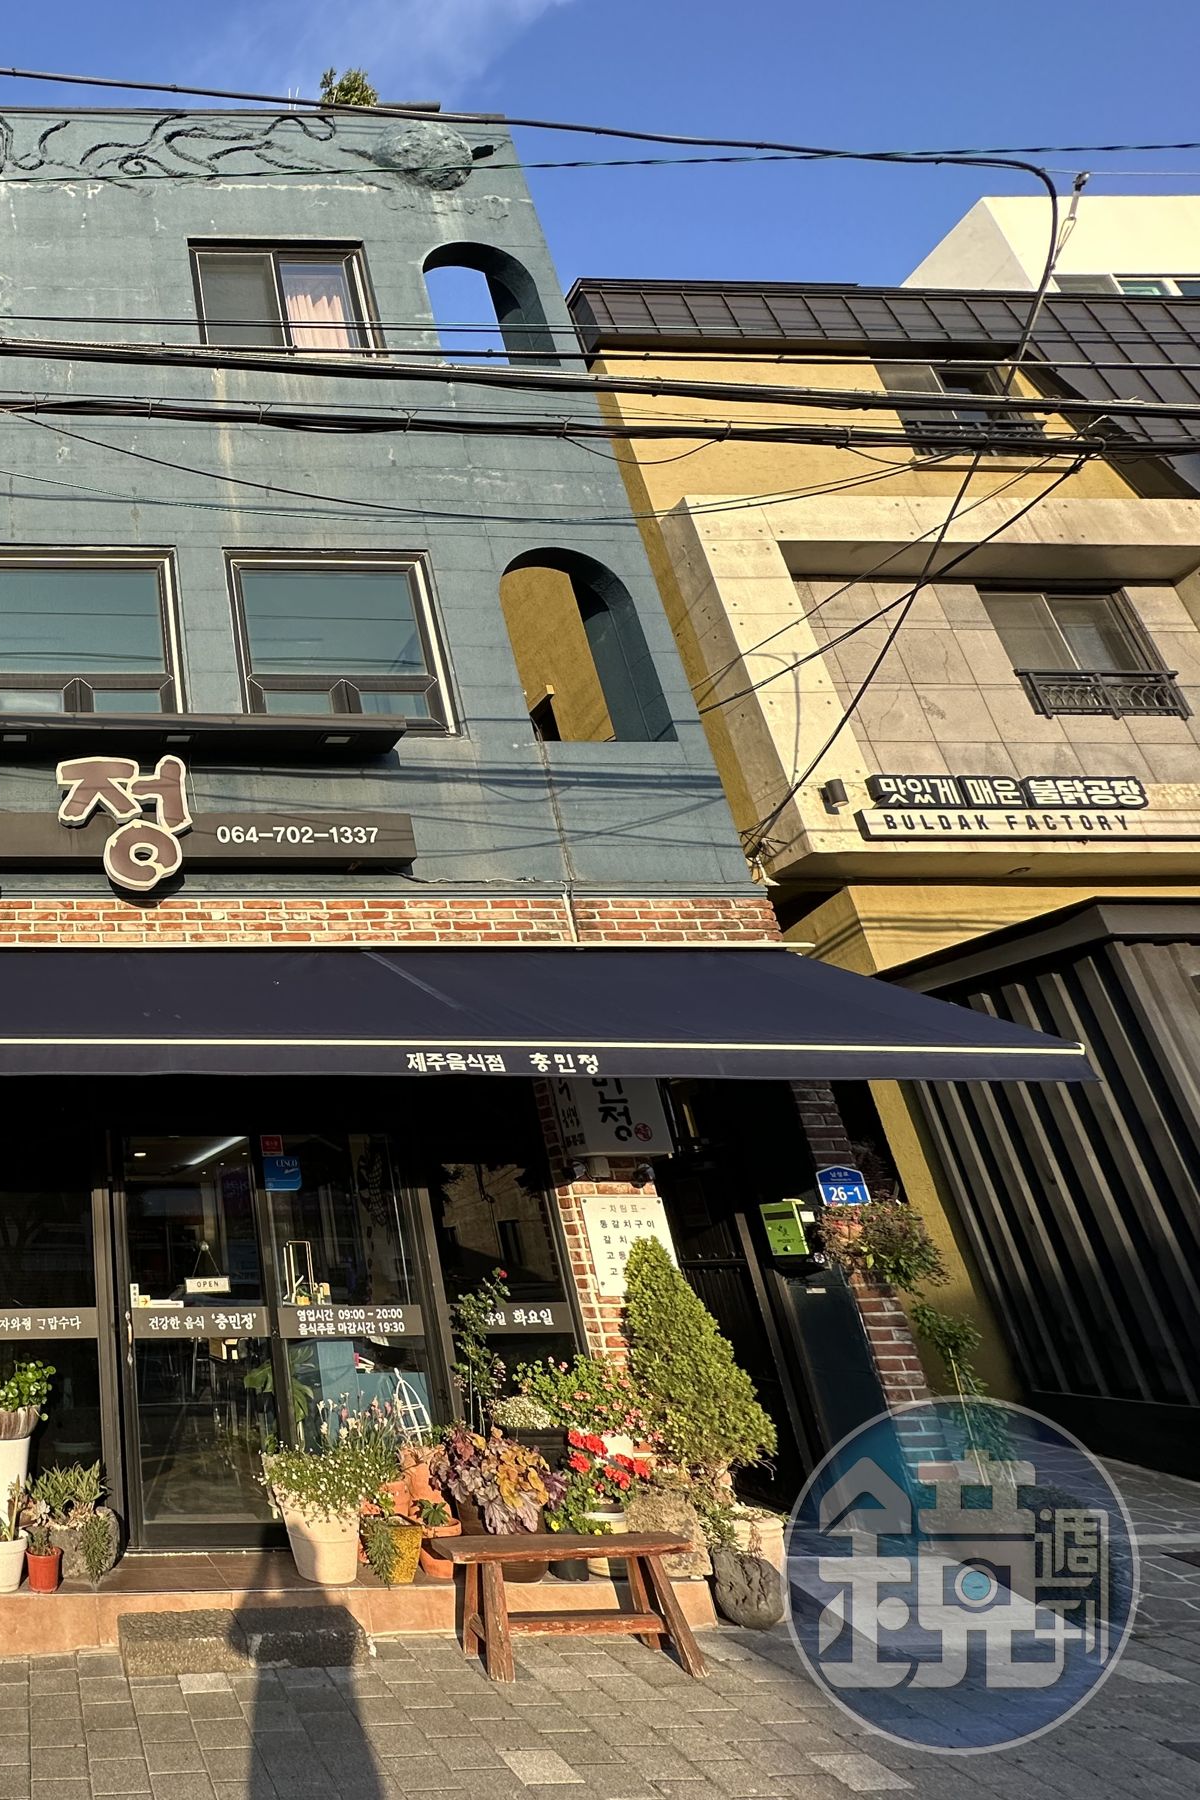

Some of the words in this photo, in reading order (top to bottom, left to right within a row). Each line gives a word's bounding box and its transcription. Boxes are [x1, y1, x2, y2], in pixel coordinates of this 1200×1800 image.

[877, 777, 965, 806] 맛있게
[967, 778, 1026, 807] 매운
[1028, 778, 1148, 806] 불닭공장
[883, 814, 990, 831] BULDAK
[1007, 814, 1130, 831] FACTORY
[215, 823, 379, 845] 064-702-1337
[406, 1052, 507, 1073] 제주음식점
[529, 1052, 600, 1075] 충민정
[828, 1186, 863, 1201] 26-1
[196, 1280, 220, 1289] OPEN
[148, 1315, 181, 1331] 건강한
[184, 1315, 205, 1331] 음식
[296, 1309, 334, 1322] 영업시간
[338, 1308, 365, 1320] 09:00
[375, 1308, 403, 1320] 20:00
[512, 1308, 555, 1327] 화요일
[297, 1322, 336, 1336] 음식주문
[337, 1321, 376, 1335] 마감시간
[378, 1321, 405, 1333] 19:30
